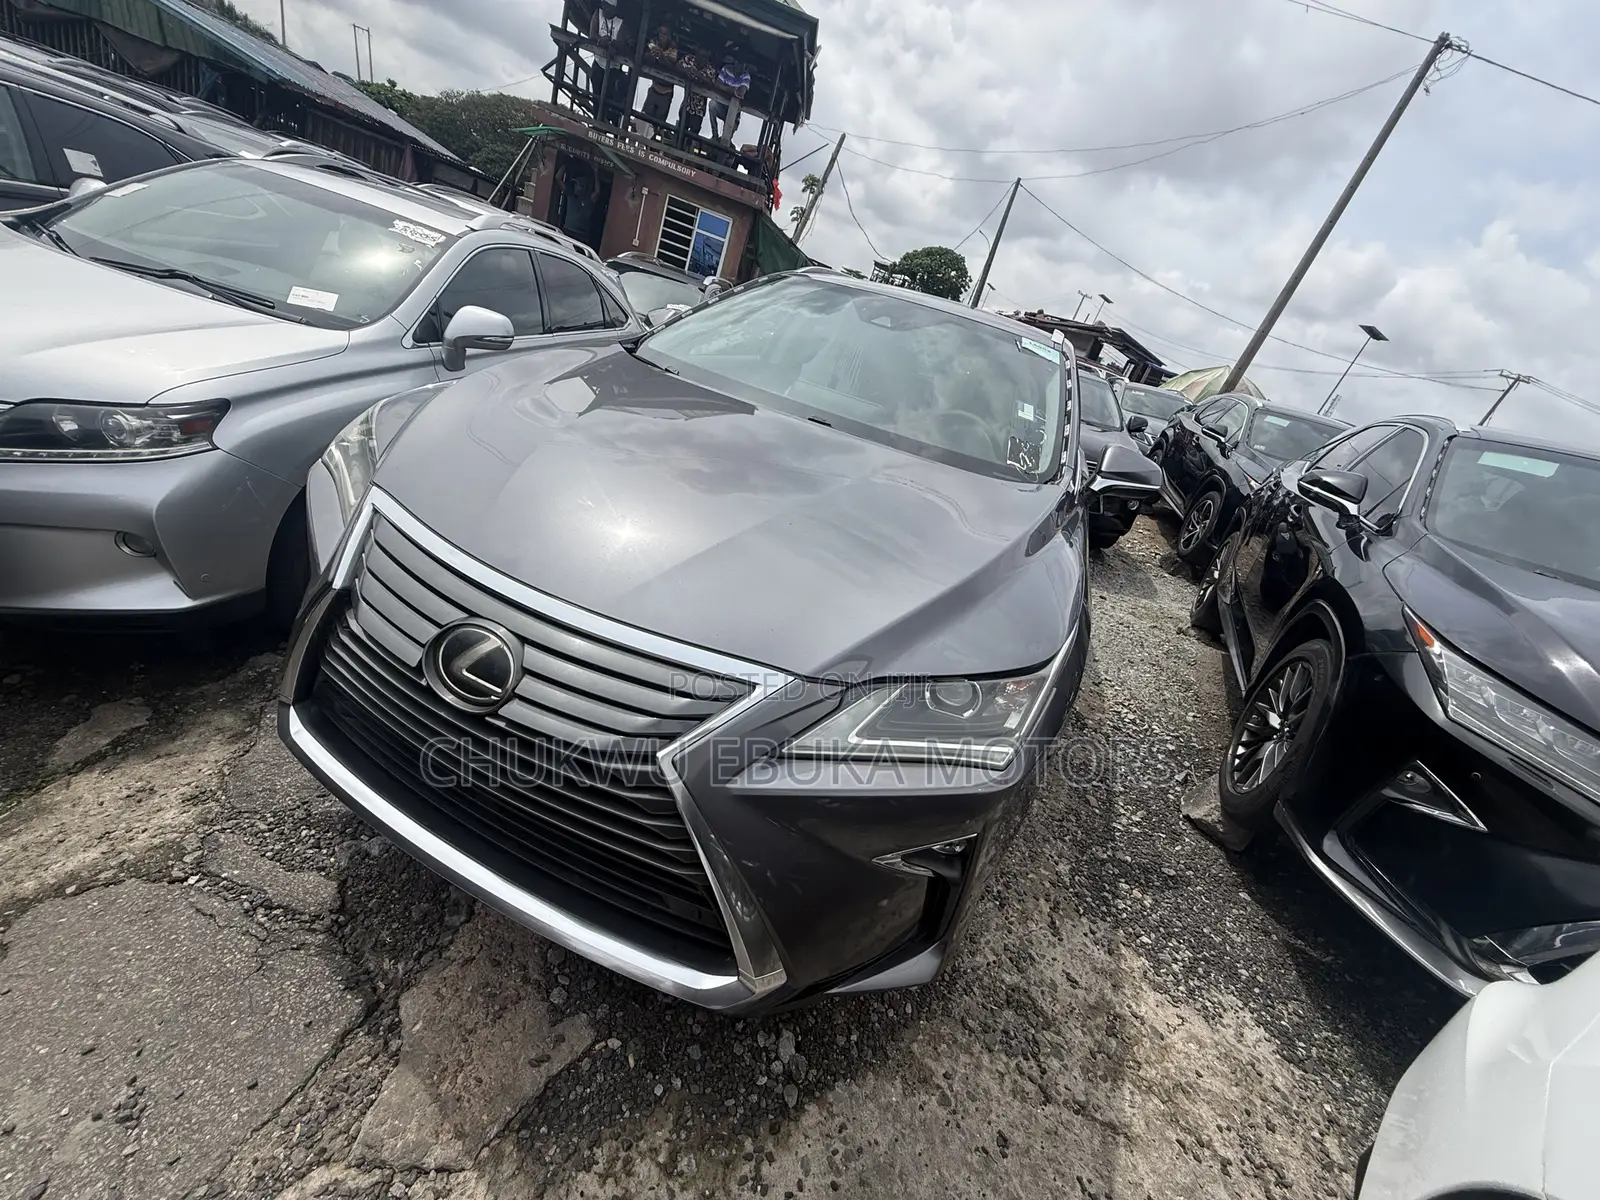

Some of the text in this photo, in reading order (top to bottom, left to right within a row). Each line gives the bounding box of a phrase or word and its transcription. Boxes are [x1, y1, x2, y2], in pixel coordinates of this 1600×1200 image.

[588, 130, 697, 178] BUYERS FEES IS COMPULSORY
